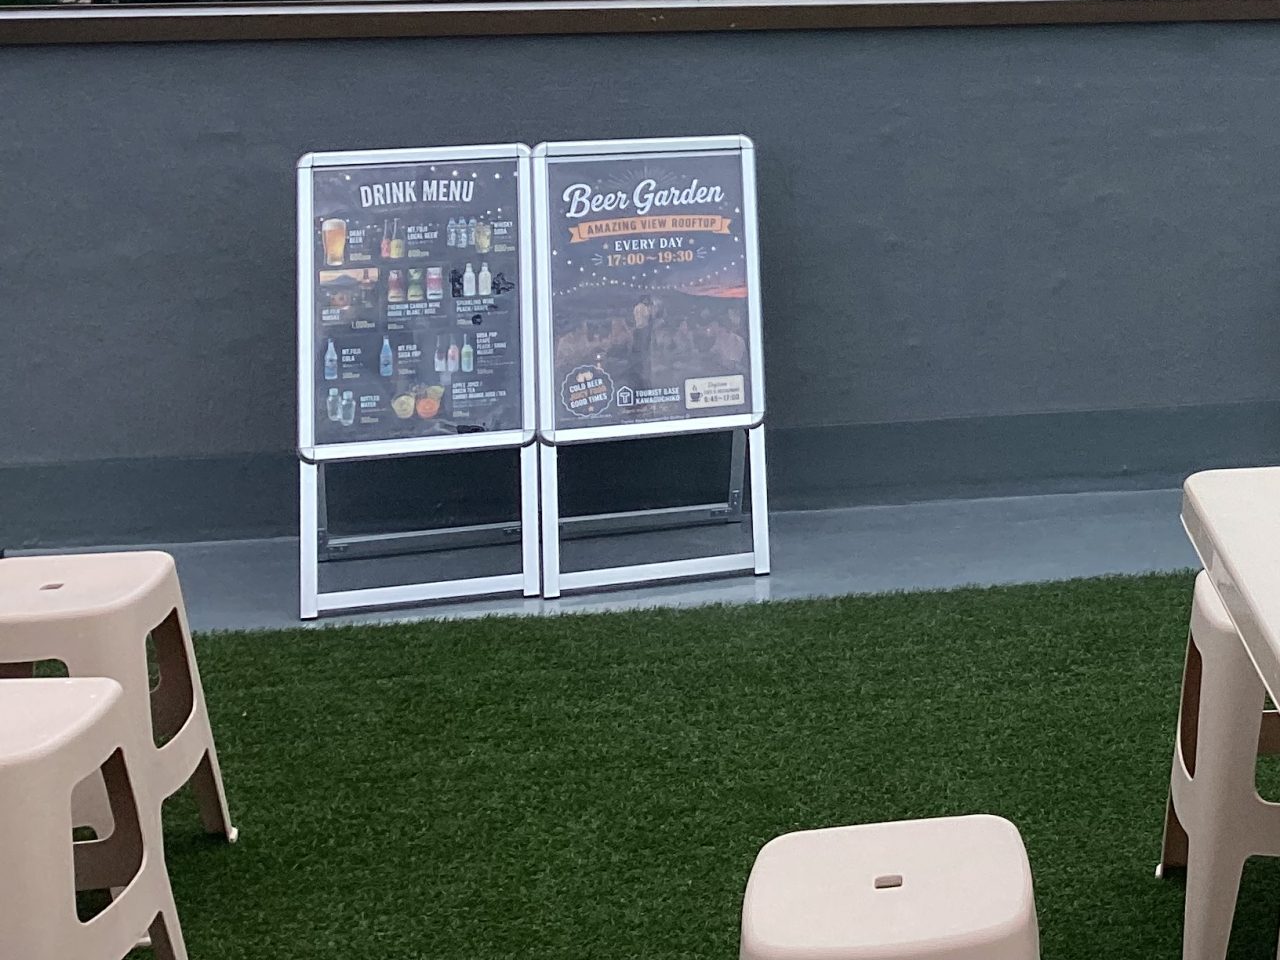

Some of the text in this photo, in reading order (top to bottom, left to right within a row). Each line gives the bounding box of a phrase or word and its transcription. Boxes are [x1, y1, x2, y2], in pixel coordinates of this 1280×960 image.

[360, 180, 474, 207] DRINK MENU
[563, 179, 724, 218] Beer Garden
[587, 217, 717, 235] AMAZING VIEW ROOFTOP
[615, 237, 684, 251] EVERY DAY
[569, 378, 604, 394] COLD BEER
[635, 387, 680, 398] TOURIST BASE
[570, 392, 608, 409] GOOD TIMES
